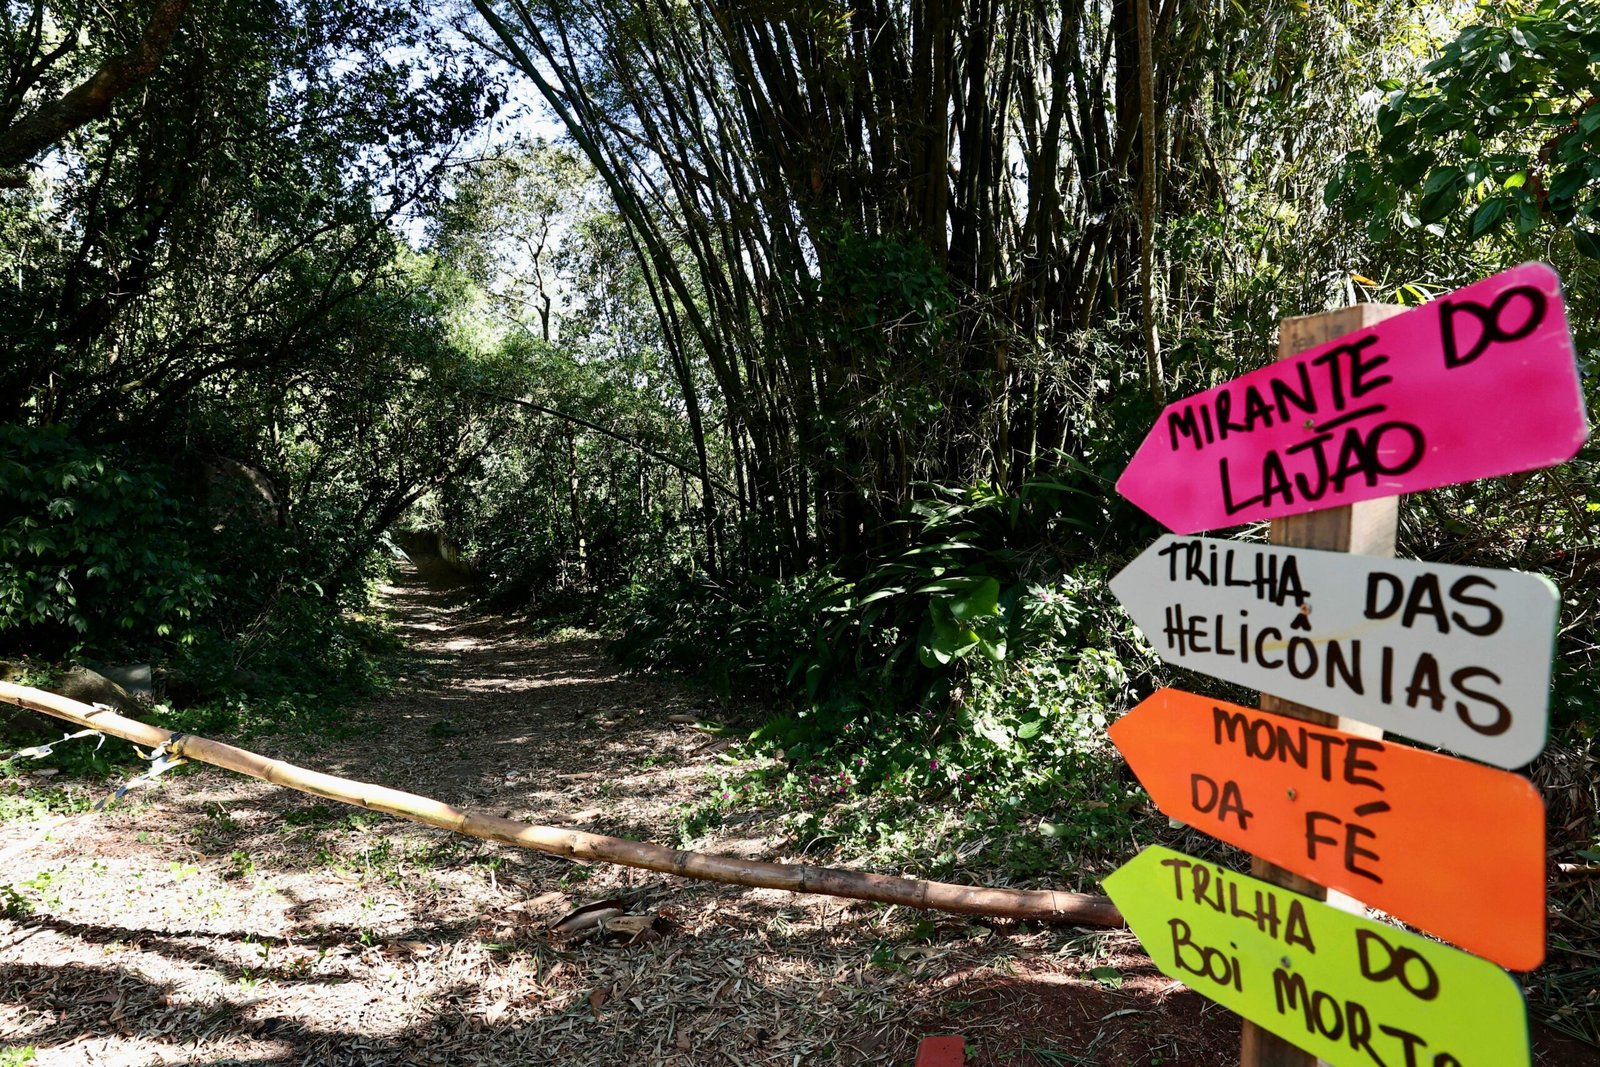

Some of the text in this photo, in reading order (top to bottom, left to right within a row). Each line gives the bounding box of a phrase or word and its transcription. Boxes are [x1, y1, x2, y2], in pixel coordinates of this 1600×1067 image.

[1168, 284, 1547, 451] MIRANTE DO
[1364, 571, 1505, 637] DAS
[1212, 706, 1386, 792] MONTE
[1190, 773, 1391, 885] DA FÉ
[1355, 928, 1441, 1002] DO
[1272, 967, 1463, 1067] MORT
